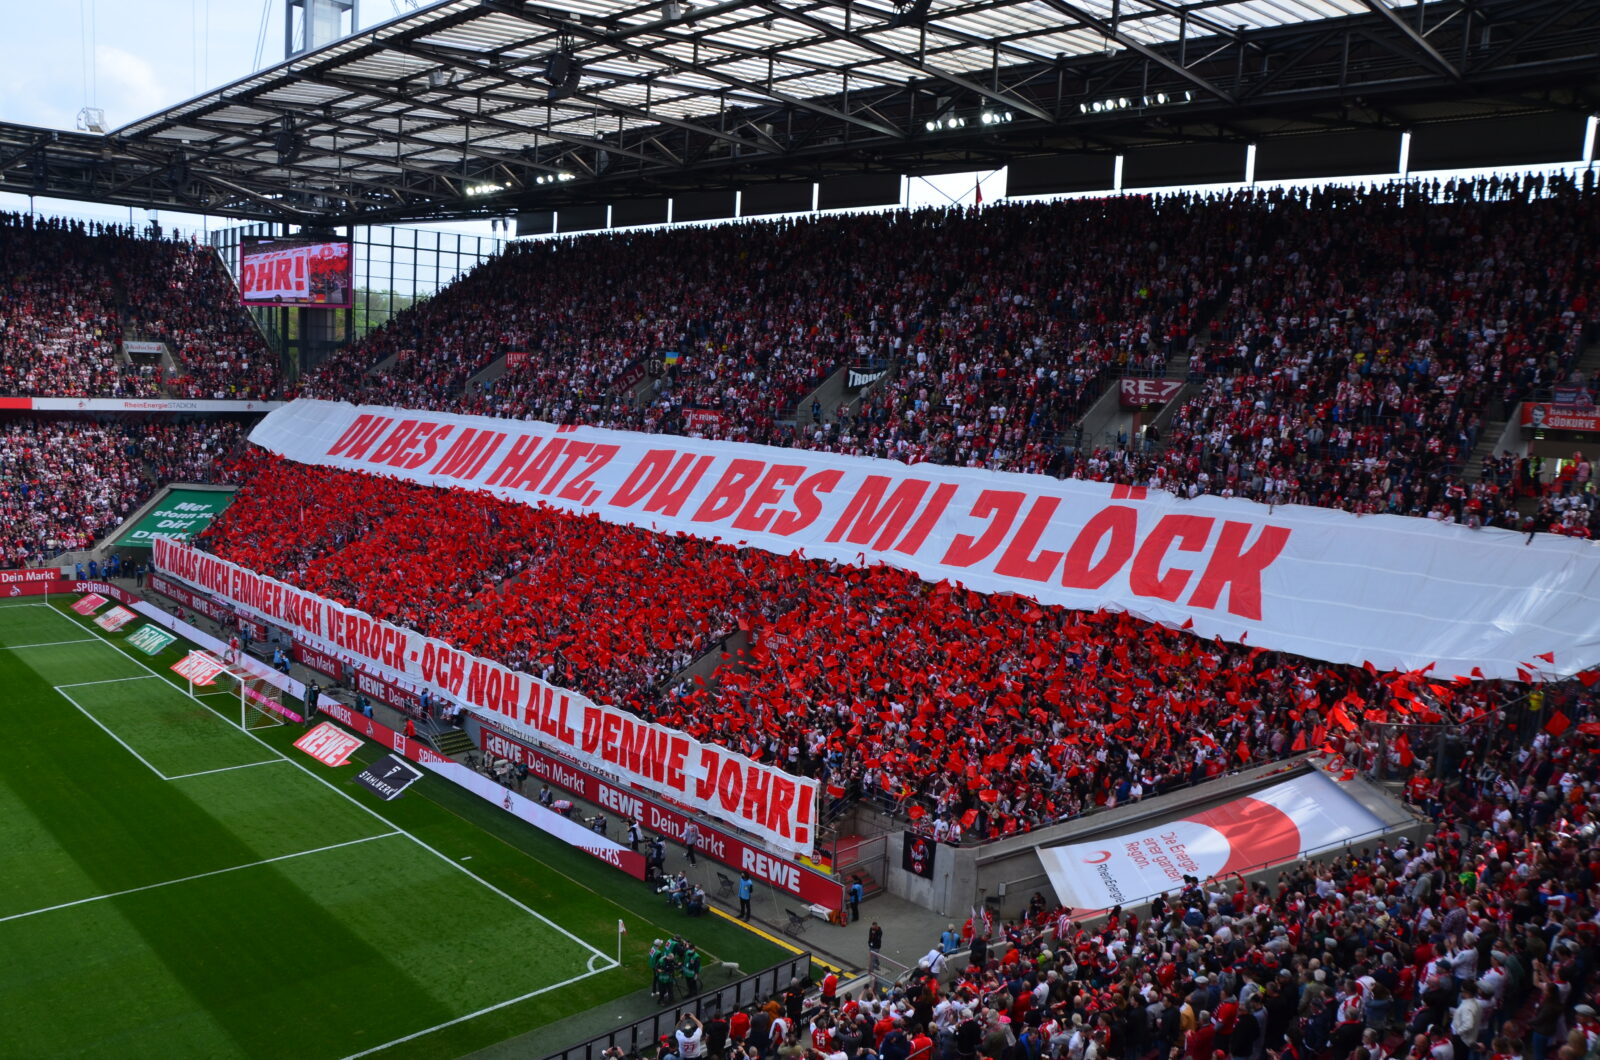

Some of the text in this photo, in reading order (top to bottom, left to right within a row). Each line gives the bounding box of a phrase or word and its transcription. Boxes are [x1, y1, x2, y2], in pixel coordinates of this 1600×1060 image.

[174, 502, 213, 511] Mer
[327, 414, 1292, 621] DU BES MI HÄTZ, DU BES MI JLÖCK
[2, 571, 55, 583] Dein Markt
[76, 580, 110, 594] SPÜRBAR
[128, 626, 169, 653] DEVK
[302, 649, 335, 676] Dein Markt
[155, 538, 167, 570] DU
[200, 556, 230, 596] MICH
[232, 569, 283, 619] EMMER
[283, 589, 322, 637] NOCH
[326, 605, 407, 673] VERRÖCK
[421, 642, 466, 697] OCH
[466, 661, 520, 720] NOH
[524, 682, 575, 746] ALL
[581, 706, 690, 792] DENNE
[695, 747, 814, 844] JOHR!
[358, 674, 385, 700] REWE
[388, 687, 405, 709] Dein
[298, 724, 355, 764] REWE
[358, 770, 397, 797] STAHLWERK
[486, 732, 522, 764] REWE
[527, 751, 550, 777] Dein
[552, 763, 586, 795] Markt
[598, 783, 644, 823] REWE
[651, 807, 680, 837] Dein
[684, 819, 726, 860] arkt
[742, 847, 801, 894] REWE
[1125, 840, 1150, 870] Region.
[1143, 837, 1185, 883] einer ganzen
[1160, 831, 1200, 874] Die Energie
[1096, 863, 1127, 903] RheinEnergie
